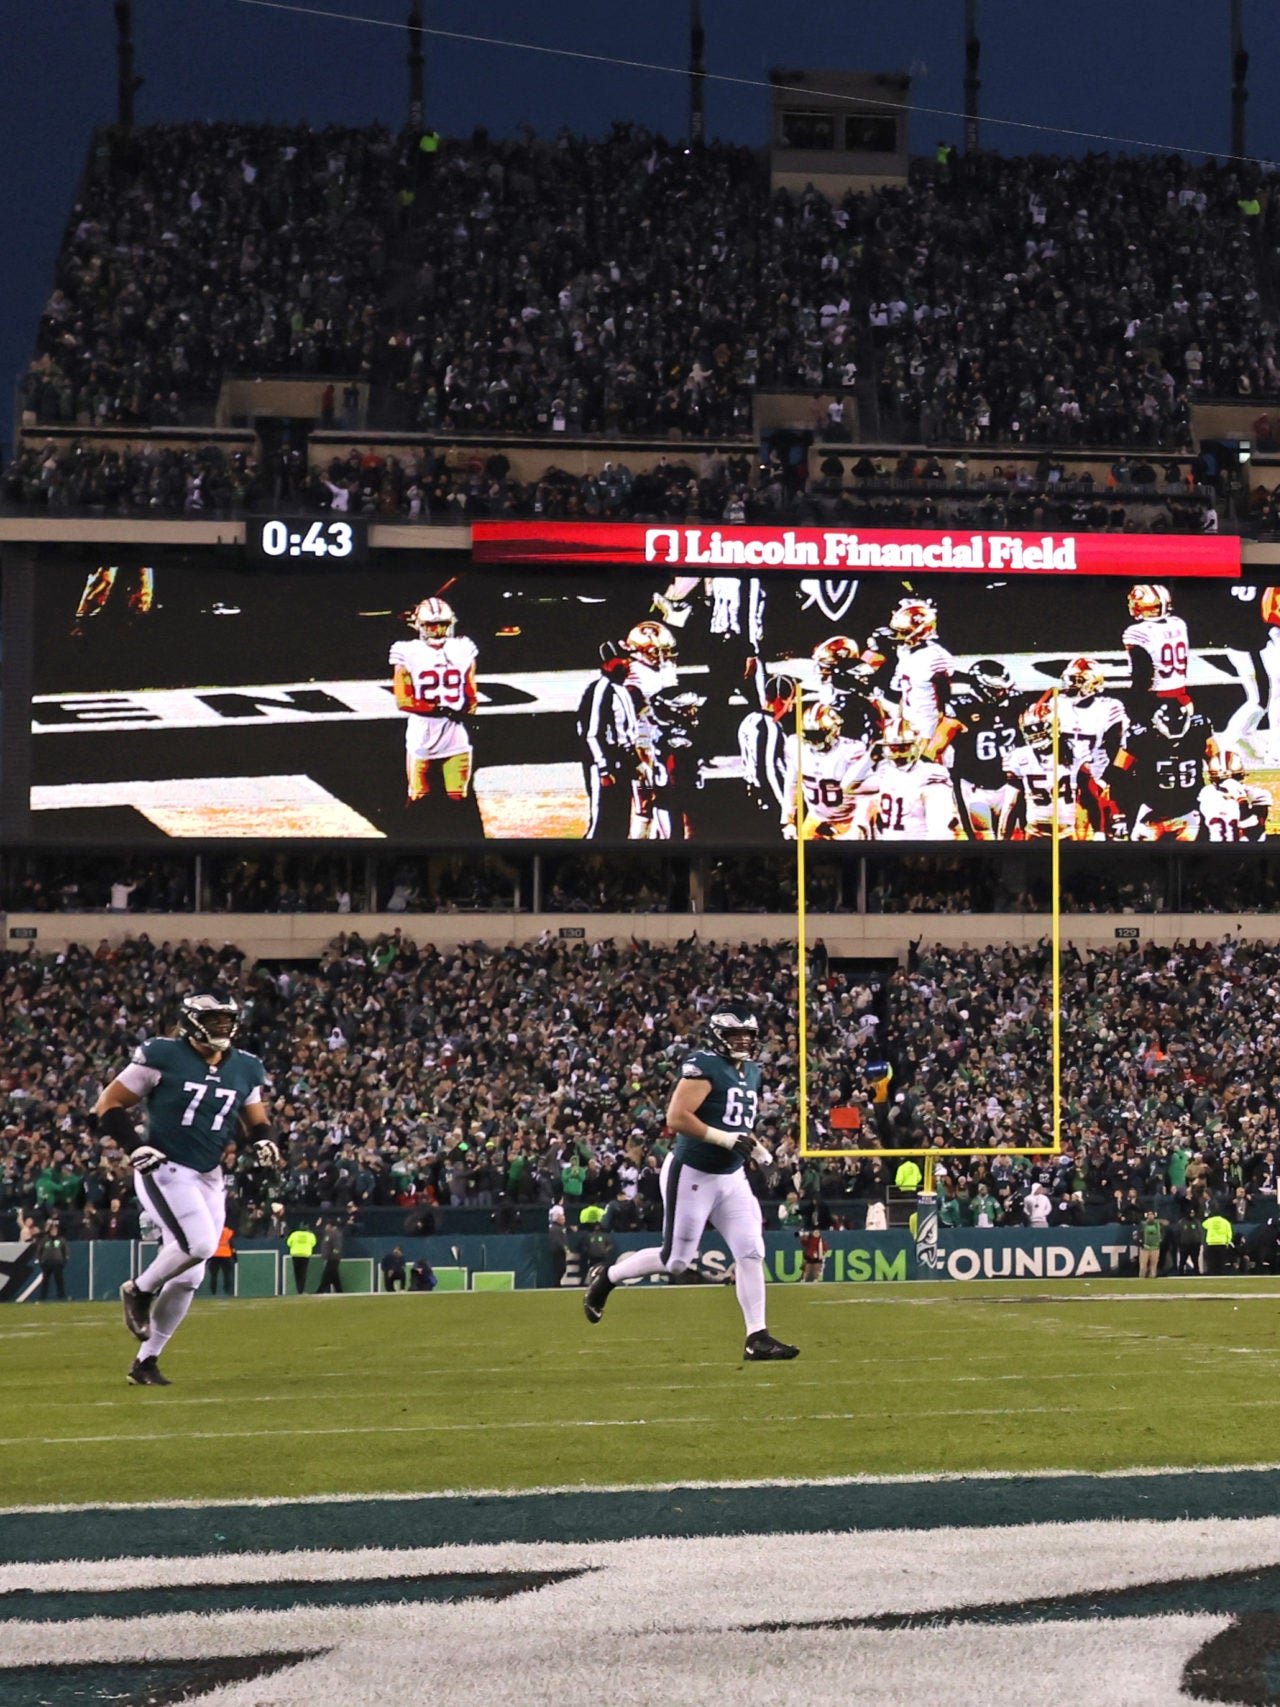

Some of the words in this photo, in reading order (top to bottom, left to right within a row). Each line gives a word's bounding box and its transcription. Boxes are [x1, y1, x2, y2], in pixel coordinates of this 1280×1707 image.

[262, 521, 352, 556] 0:43
[684, 530, 819, 565] Lincoln
[823, 533, 984, 568] Financial
[988, 536, 1077, 570] Field
[418, 669, 462, 704] 29
[181, 1082, 237, 1131] 77
[723, 1087, 758, 1129] 63
